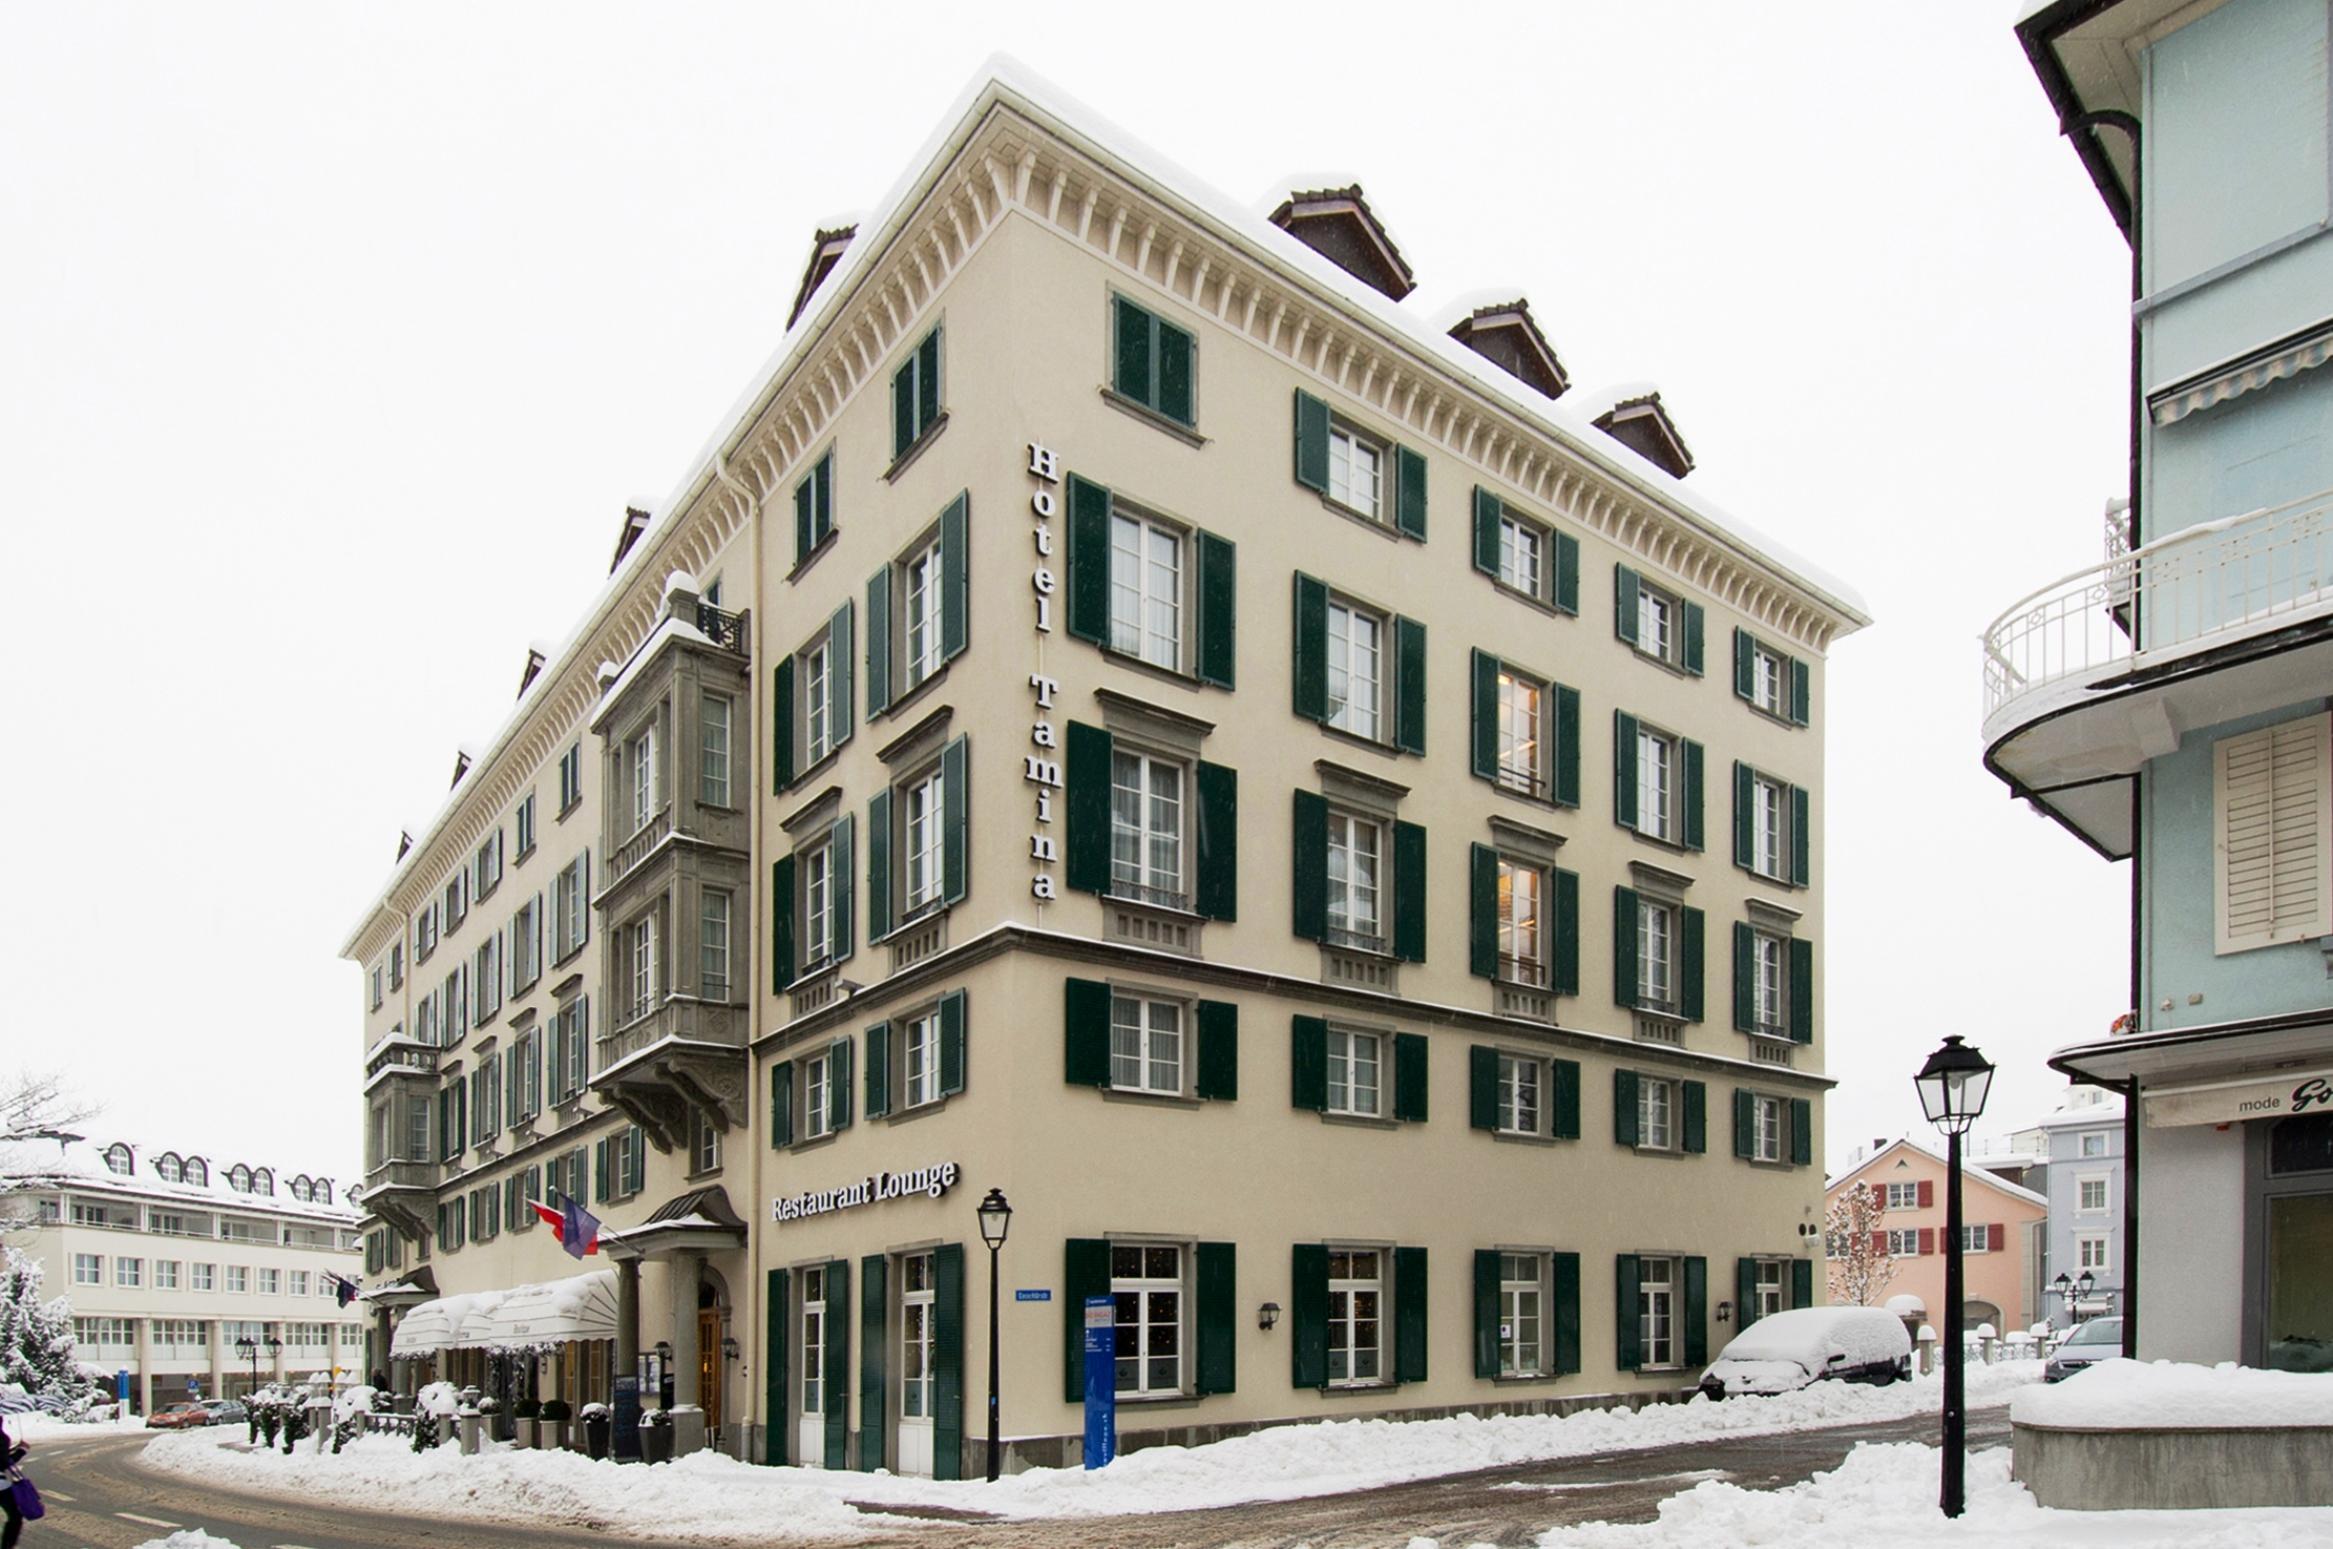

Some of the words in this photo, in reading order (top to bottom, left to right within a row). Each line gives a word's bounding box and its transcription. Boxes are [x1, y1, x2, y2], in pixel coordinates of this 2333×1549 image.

[1028, 443, 1059, 633] Hotel
[1025, 673, 1063, 900] Tamina
[2239, 1096, 2280, 1112] mode
[771, 1177, 873, 1222] Restaurant
[875, 1161, 959, 1199] Lounge
